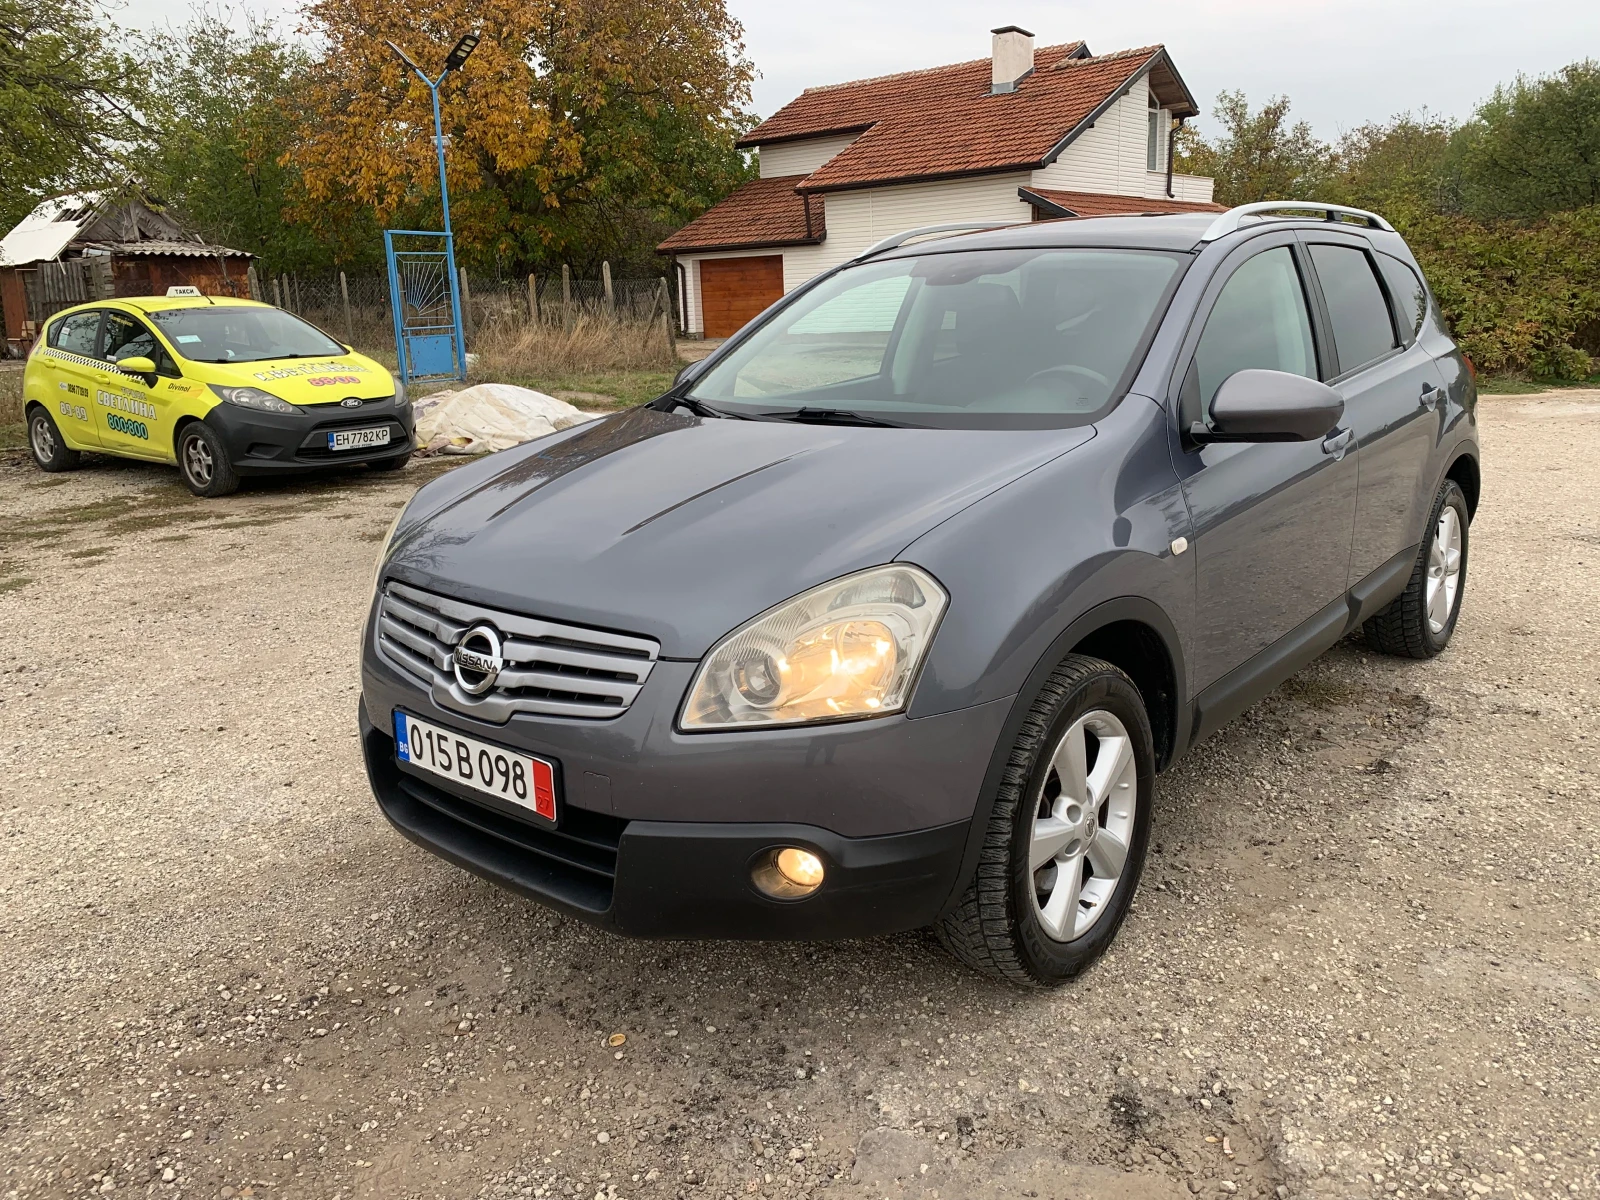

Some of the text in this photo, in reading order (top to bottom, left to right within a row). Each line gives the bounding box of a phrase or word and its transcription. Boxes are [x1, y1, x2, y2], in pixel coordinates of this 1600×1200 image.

[167, 382, 191, 393] Divinol
[60, 401, 88, 422] 89-89
[96, 389, 157, 420] СВЕТЛИНА
[454, 647, 494, 670] NISSAN
[398, 741, 409, 755] BG
